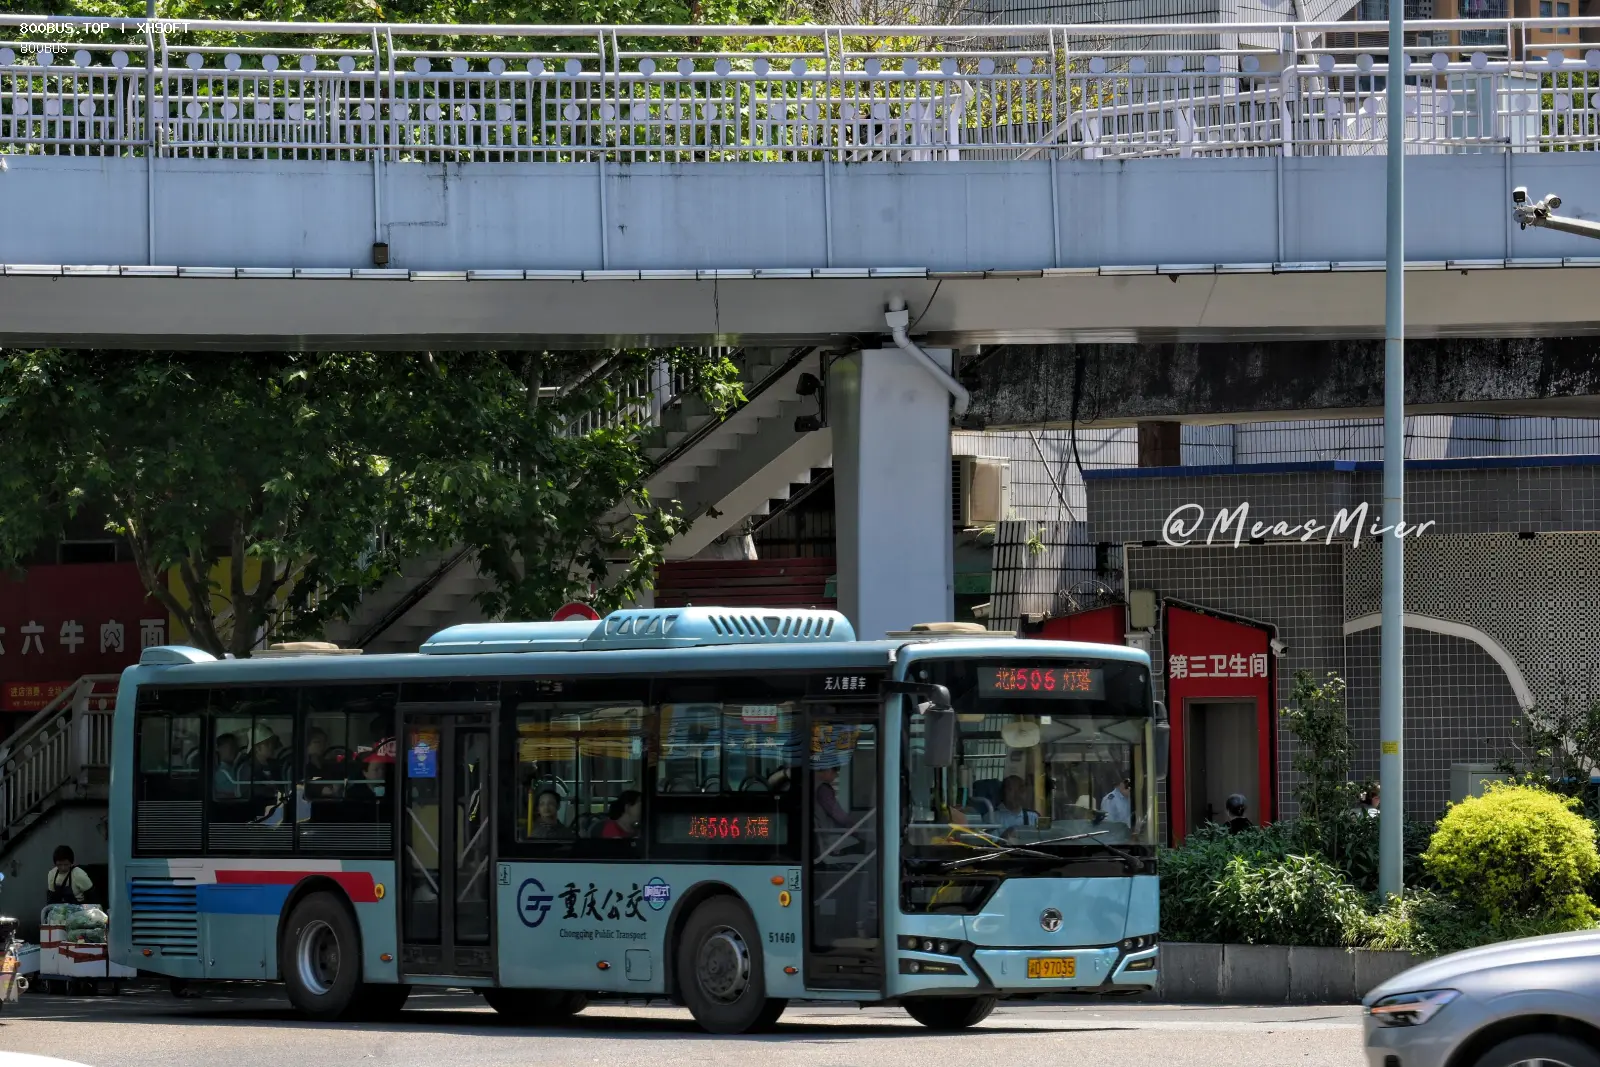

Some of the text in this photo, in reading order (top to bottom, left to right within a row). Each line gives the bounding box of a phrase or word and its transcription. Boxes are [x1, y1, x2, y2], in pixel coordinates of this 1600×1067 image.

[0, 619, 165, 655] 六牛肉面
[1168, 653, 1269, 680] 第三卫生间
[824, 676, 867, 691] 无人售票车
[10, 686, 68, 698] 进店消费，全场
[558, 882, 648, 922] 重庆公交
[559, 928, 647, 941] Chongqing Public Transport
[769, 932, 796, 944] 51460
